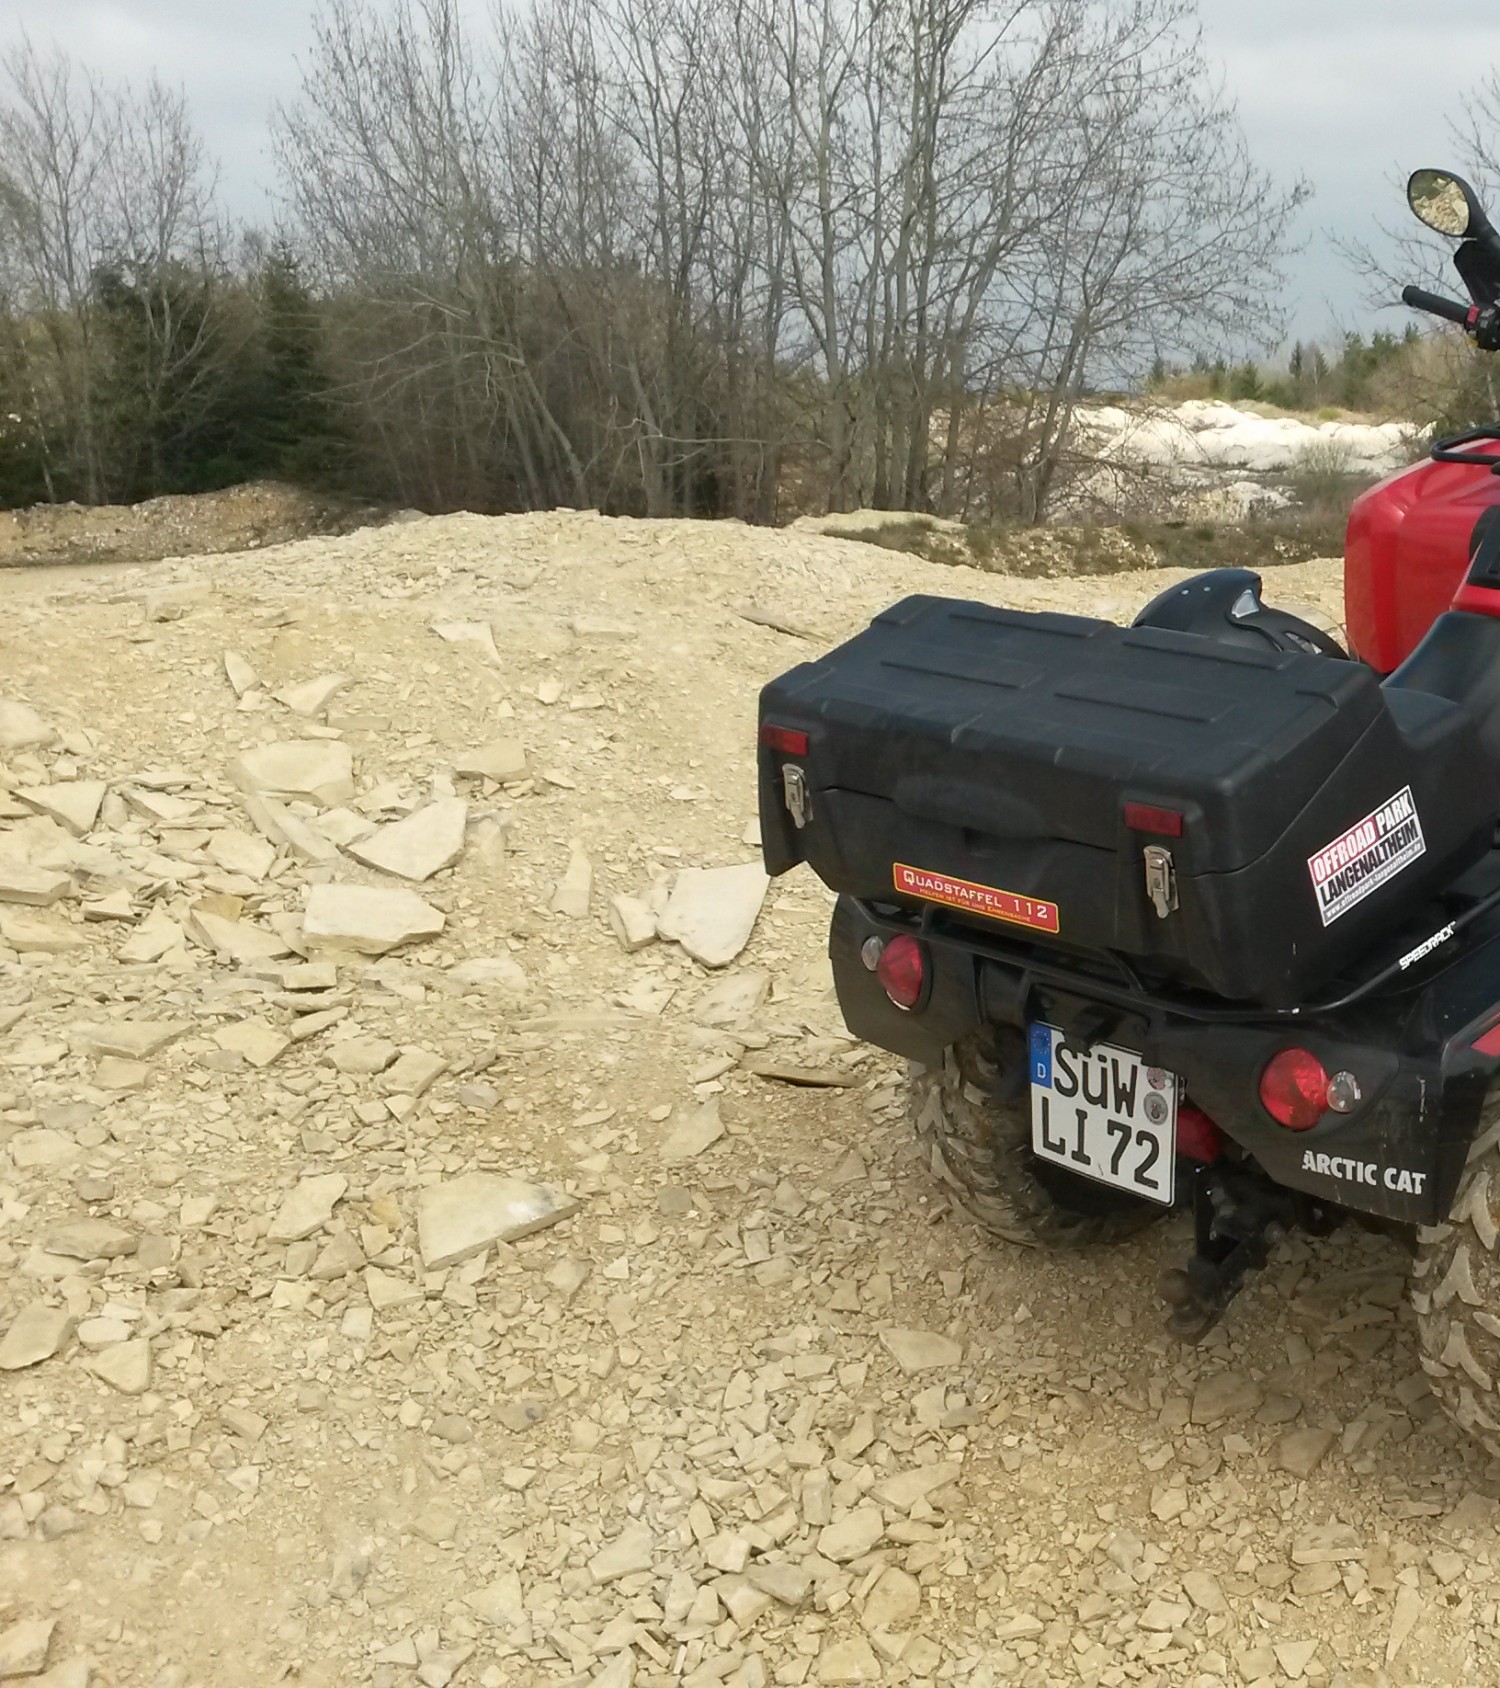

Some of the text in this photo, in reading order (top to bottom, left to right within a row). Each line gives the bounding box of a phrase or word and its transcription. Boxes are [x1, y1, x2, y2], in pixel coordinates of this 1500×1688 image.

[1313, 792, 1413, 882] OFFROAD PARK
[1319, 818, 1419, 907] LANGENALTHEIM
[1013, 899, 1048, 919] 112
[1037, 1063, 1047, 1079] D
[1054, 1041, 1138, 1119] SÜW
[1041, 1096, 1160, 1190] LI 72
[1302, 1150, 1427, 1195] ARCTIC CAT
